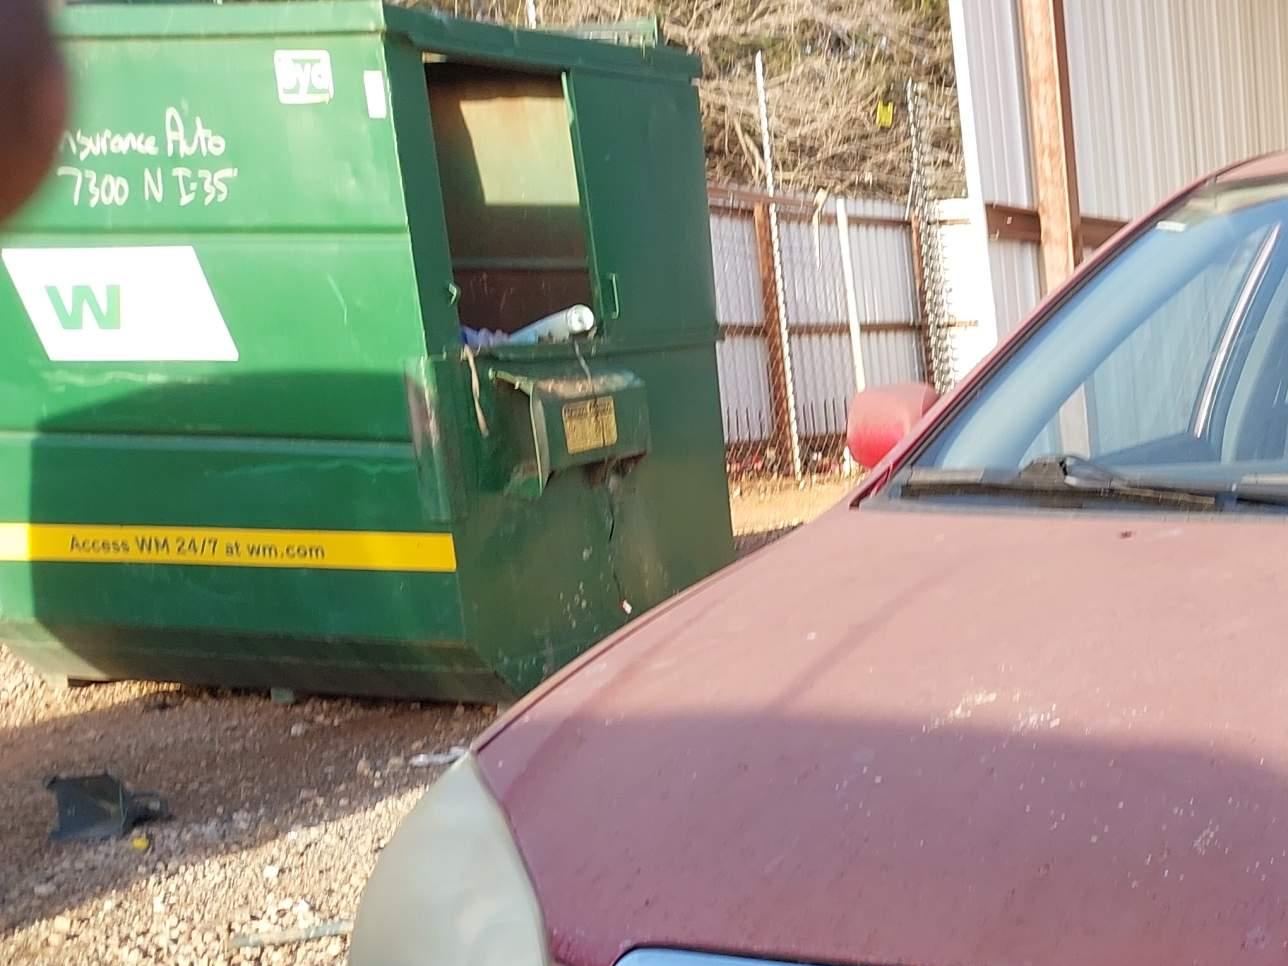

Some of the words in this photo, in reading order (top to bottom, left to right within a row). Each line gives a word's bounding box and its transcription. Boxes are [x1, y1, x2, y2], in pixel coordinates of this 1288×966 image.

[60, 128, 160, 161] nsurance
[165, 106, 226, 159] Auto
[57, 166, 129, 208] 7300
[143, 167, 164, 203] N
[70, 534, 130, 554] Access
[135, 536, 170, 555] WM
[175, 537, 218, 556] 24/7
[225, 541, 242, 557] at
[246, 544, 326, 560] wm.com
